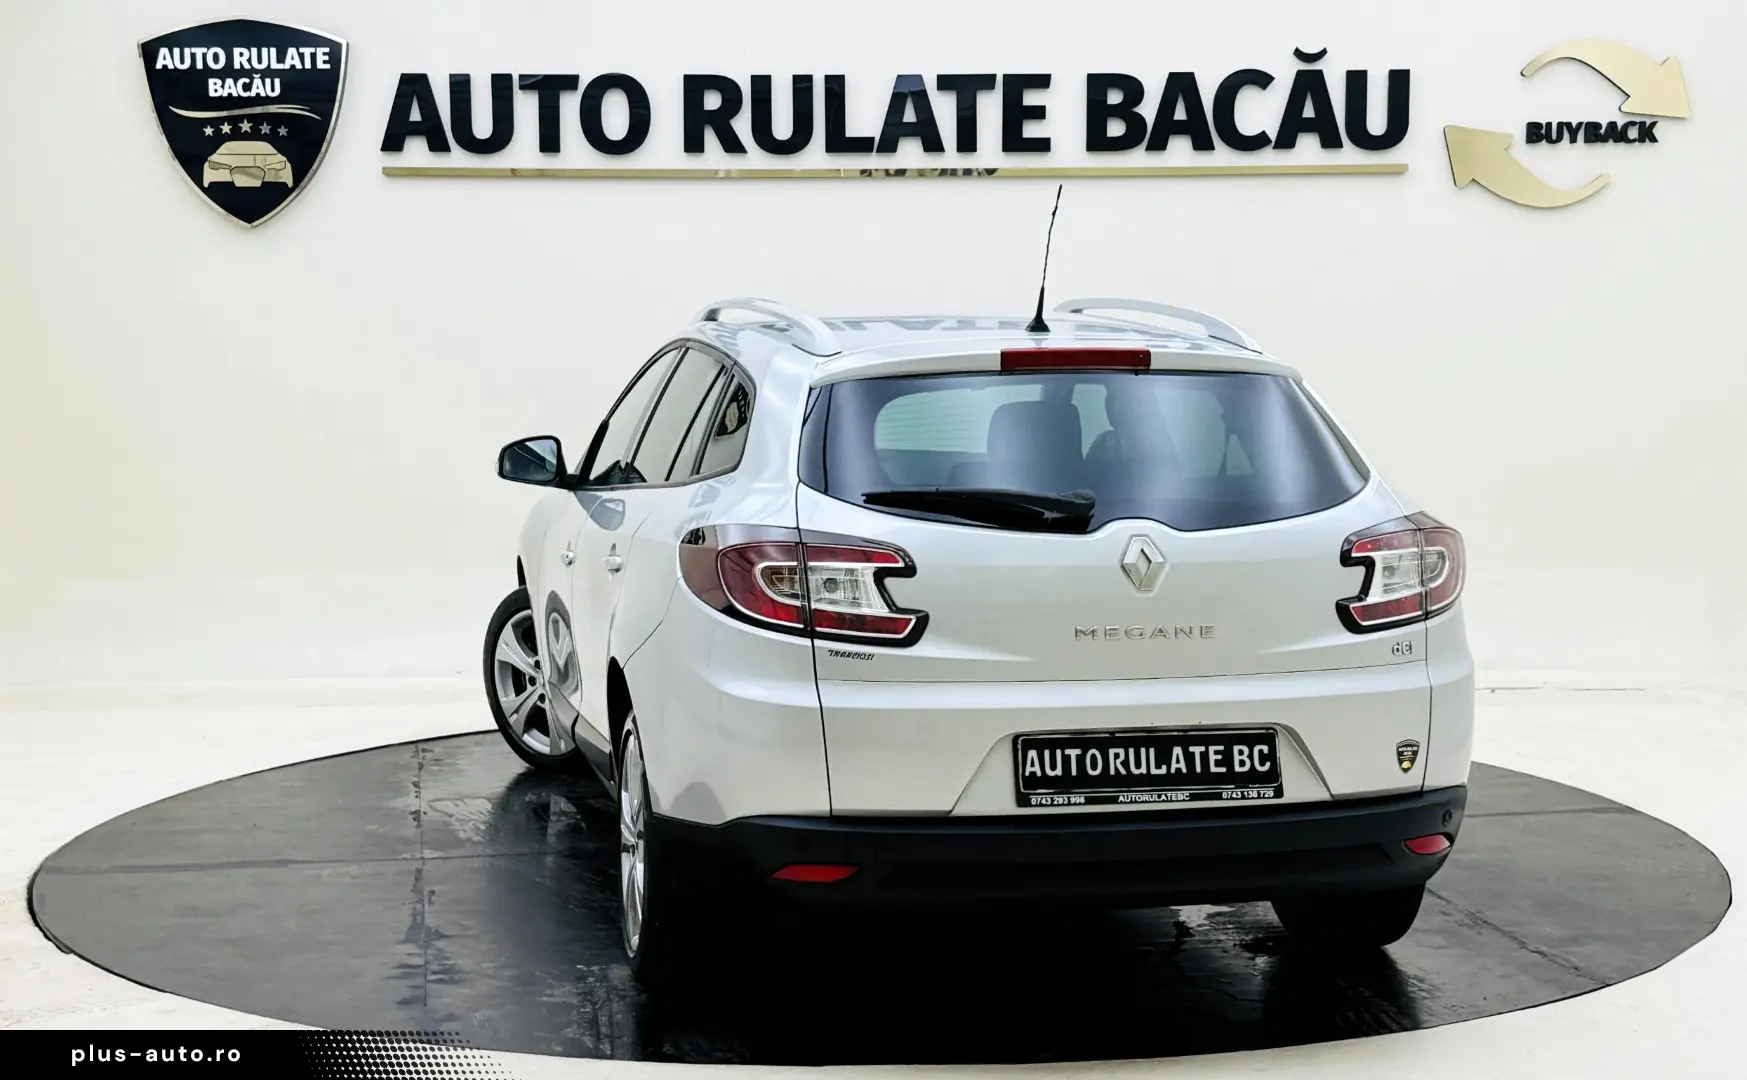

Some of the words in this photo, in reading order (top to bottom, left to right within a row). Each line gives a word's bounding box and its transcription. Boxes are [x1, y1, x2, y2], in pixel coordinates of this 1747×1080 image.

[155, 46, 226, 70] AUTO
[232, 46, 331, 70] RULATE
[207, 73, 281, 97] BACĂU
[380, 72, 651, 155] AUTO
[683, 73, 1051, 155] RULATE
[1085, 46, 1411, 152] BACĂU
[1525, 120, 1659, 145] BUYBACK
[1074, 624, 1218, 641] MEGANE
[1024, 748, 1103, 777] AUTO
[1109, 745, 1226, 775] RULATE
[1233, 744, 1272, 772] BC
[1031, 797, 1051, 805] 0743
[1118, 792, 1190, 803] AUTORULATEBC
[1222, 791, 1241, 799] 0743
